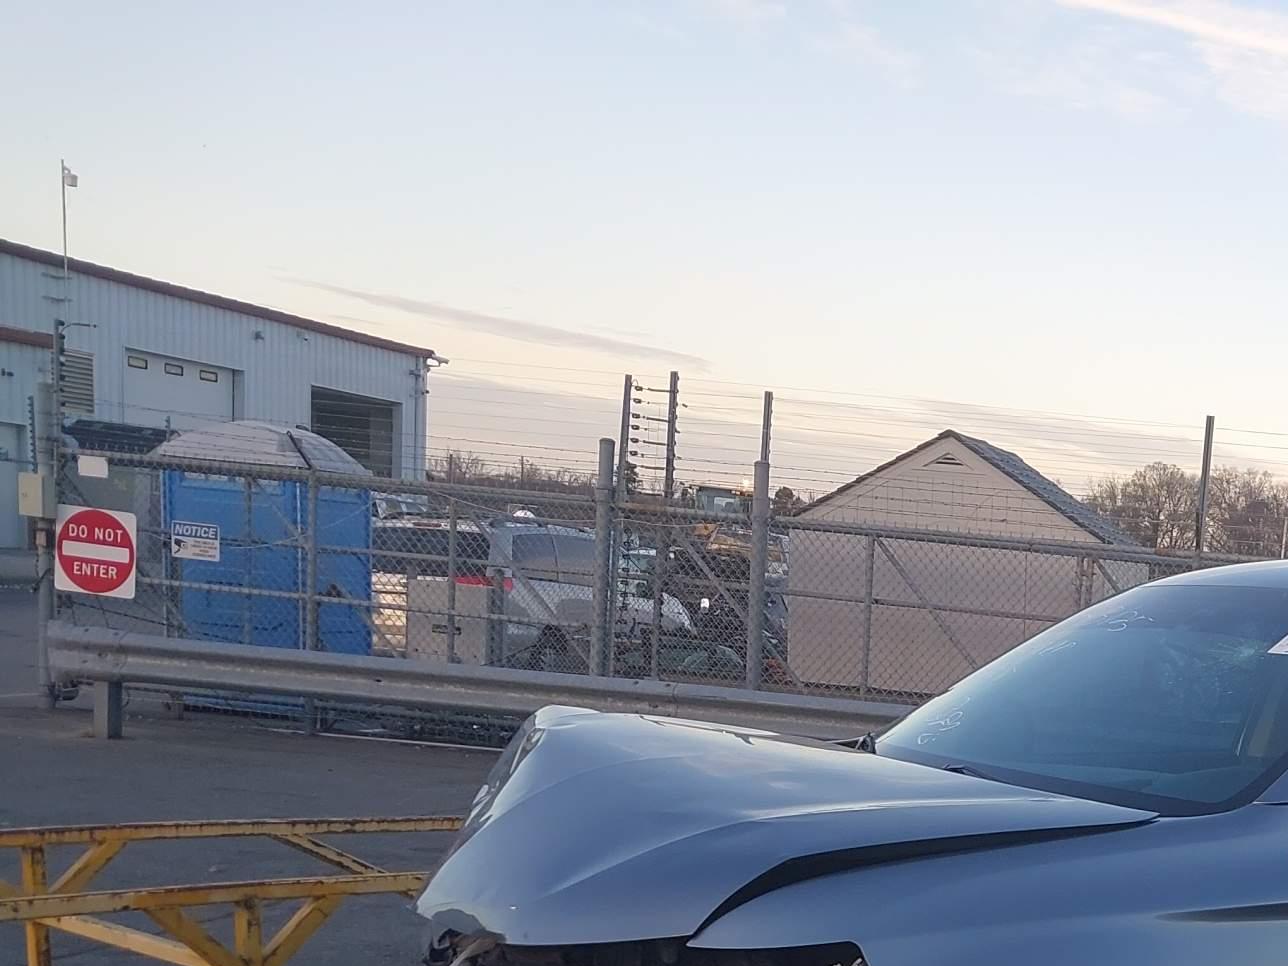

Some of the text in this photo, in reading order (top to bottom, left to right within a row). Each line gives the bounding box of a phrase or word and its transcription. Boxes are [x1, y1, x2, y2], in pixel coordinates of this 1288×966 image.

[68, 524, 123, 544] DO NOT
[174, 523, 217, 538] NOTICE
[73, 561, 117, 580] ENTER
